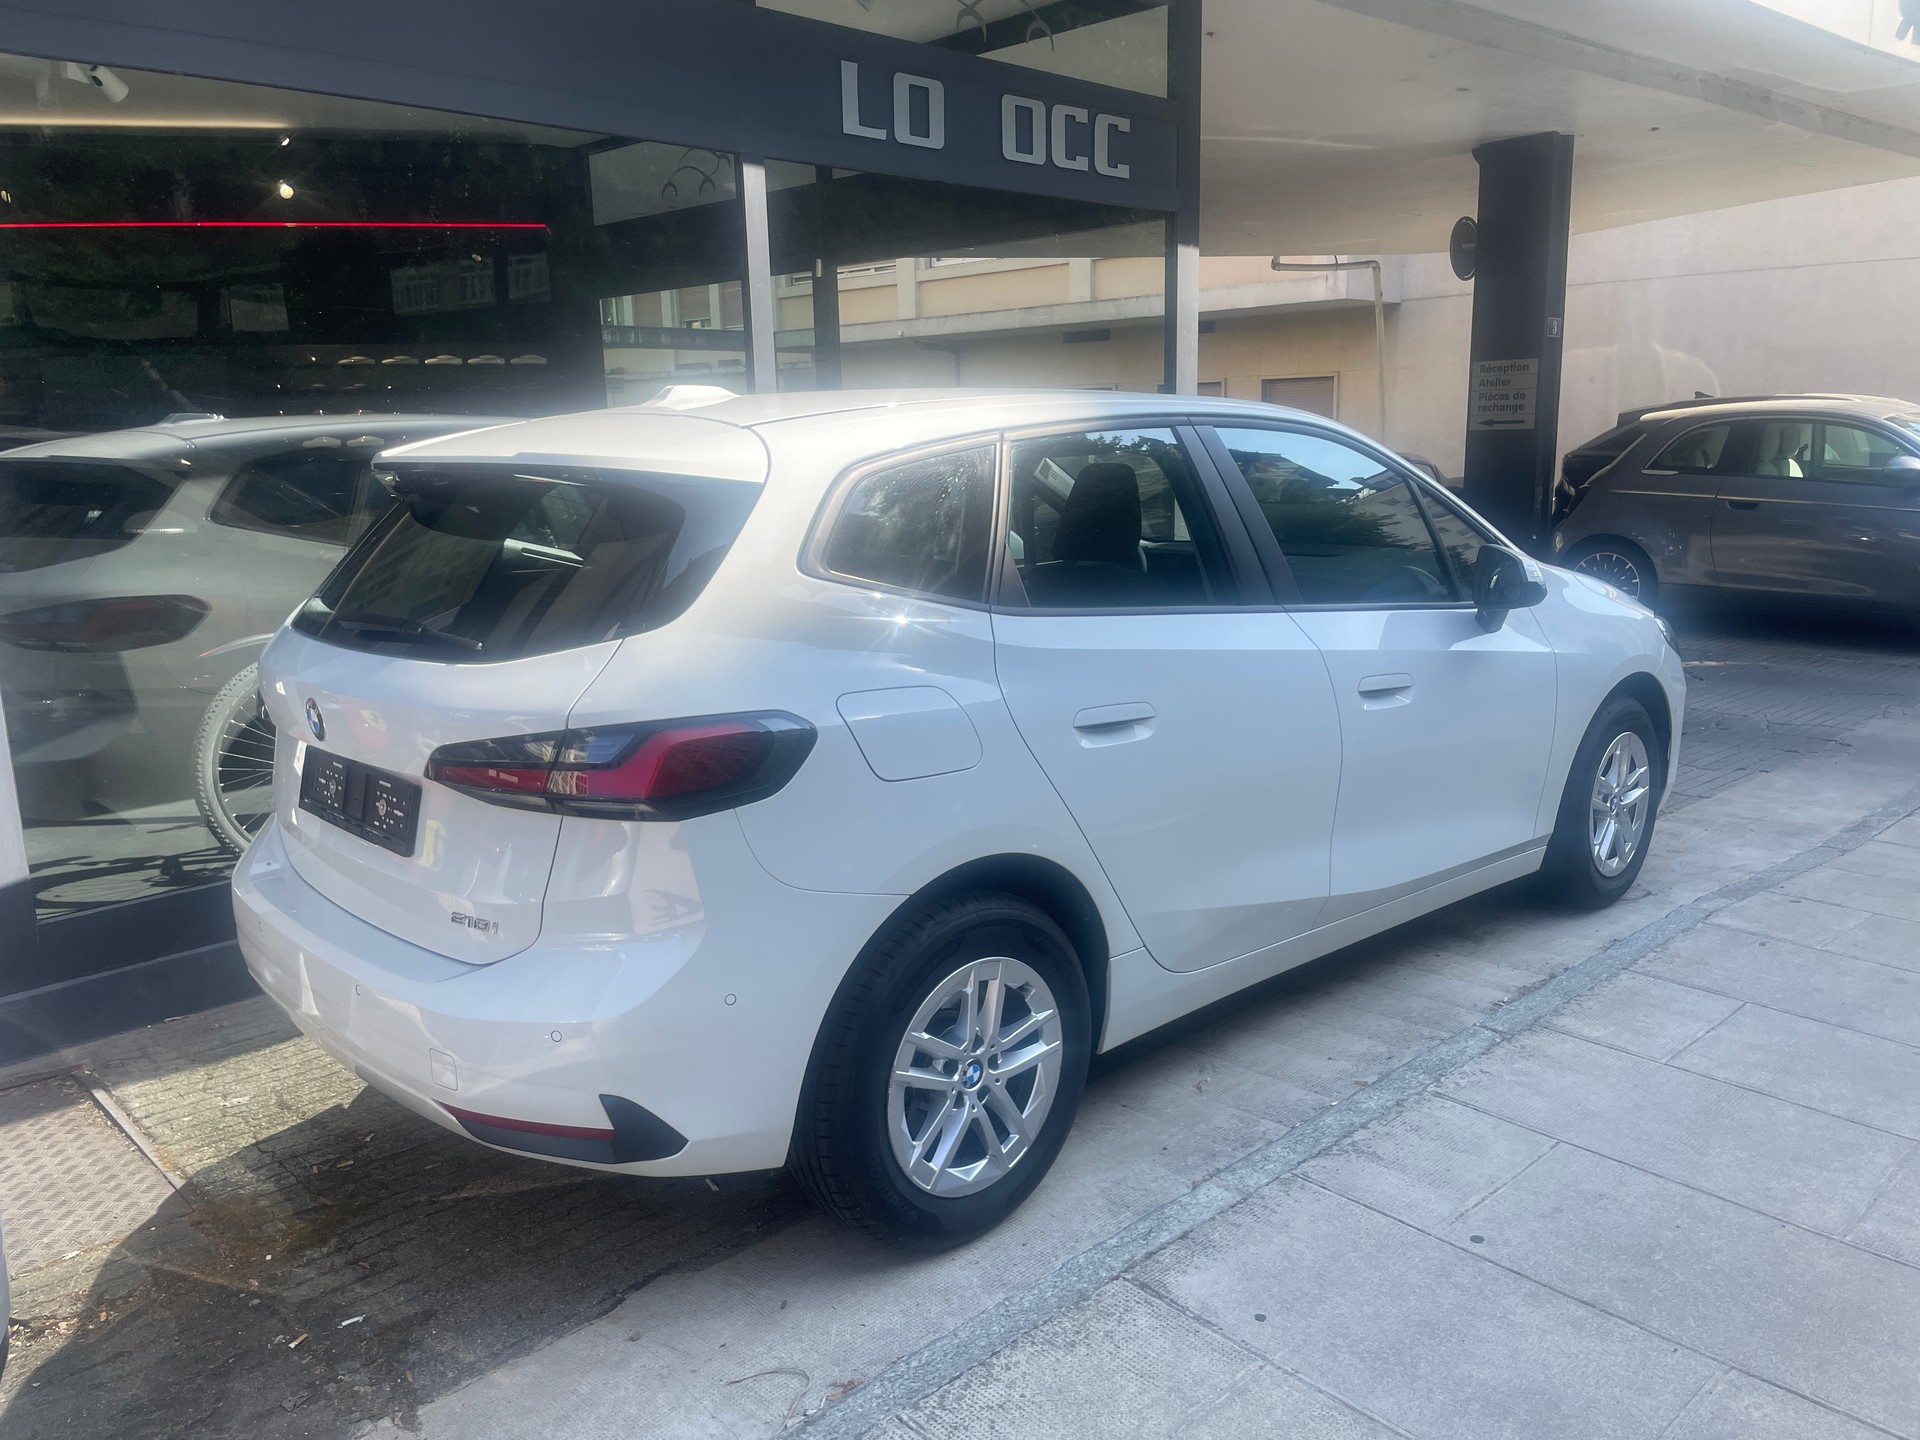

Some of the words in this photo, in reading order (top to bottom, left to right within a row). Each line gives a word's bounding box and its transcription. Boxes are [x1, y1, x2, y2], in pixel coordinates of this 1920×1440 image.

[841, 60, 945, 150] LO
[1001, 94, 1130, 179] OCC
[1480, 362, 1530, 374] Réception
[1478, 377, 1512, 388] Atelier
[1478, 391, 1510, 401] Pièces
[1513, 390, 1526, 400] de
[1477, 402, 1525, 413] rechange
[451, 911, 499, 935] 218i
